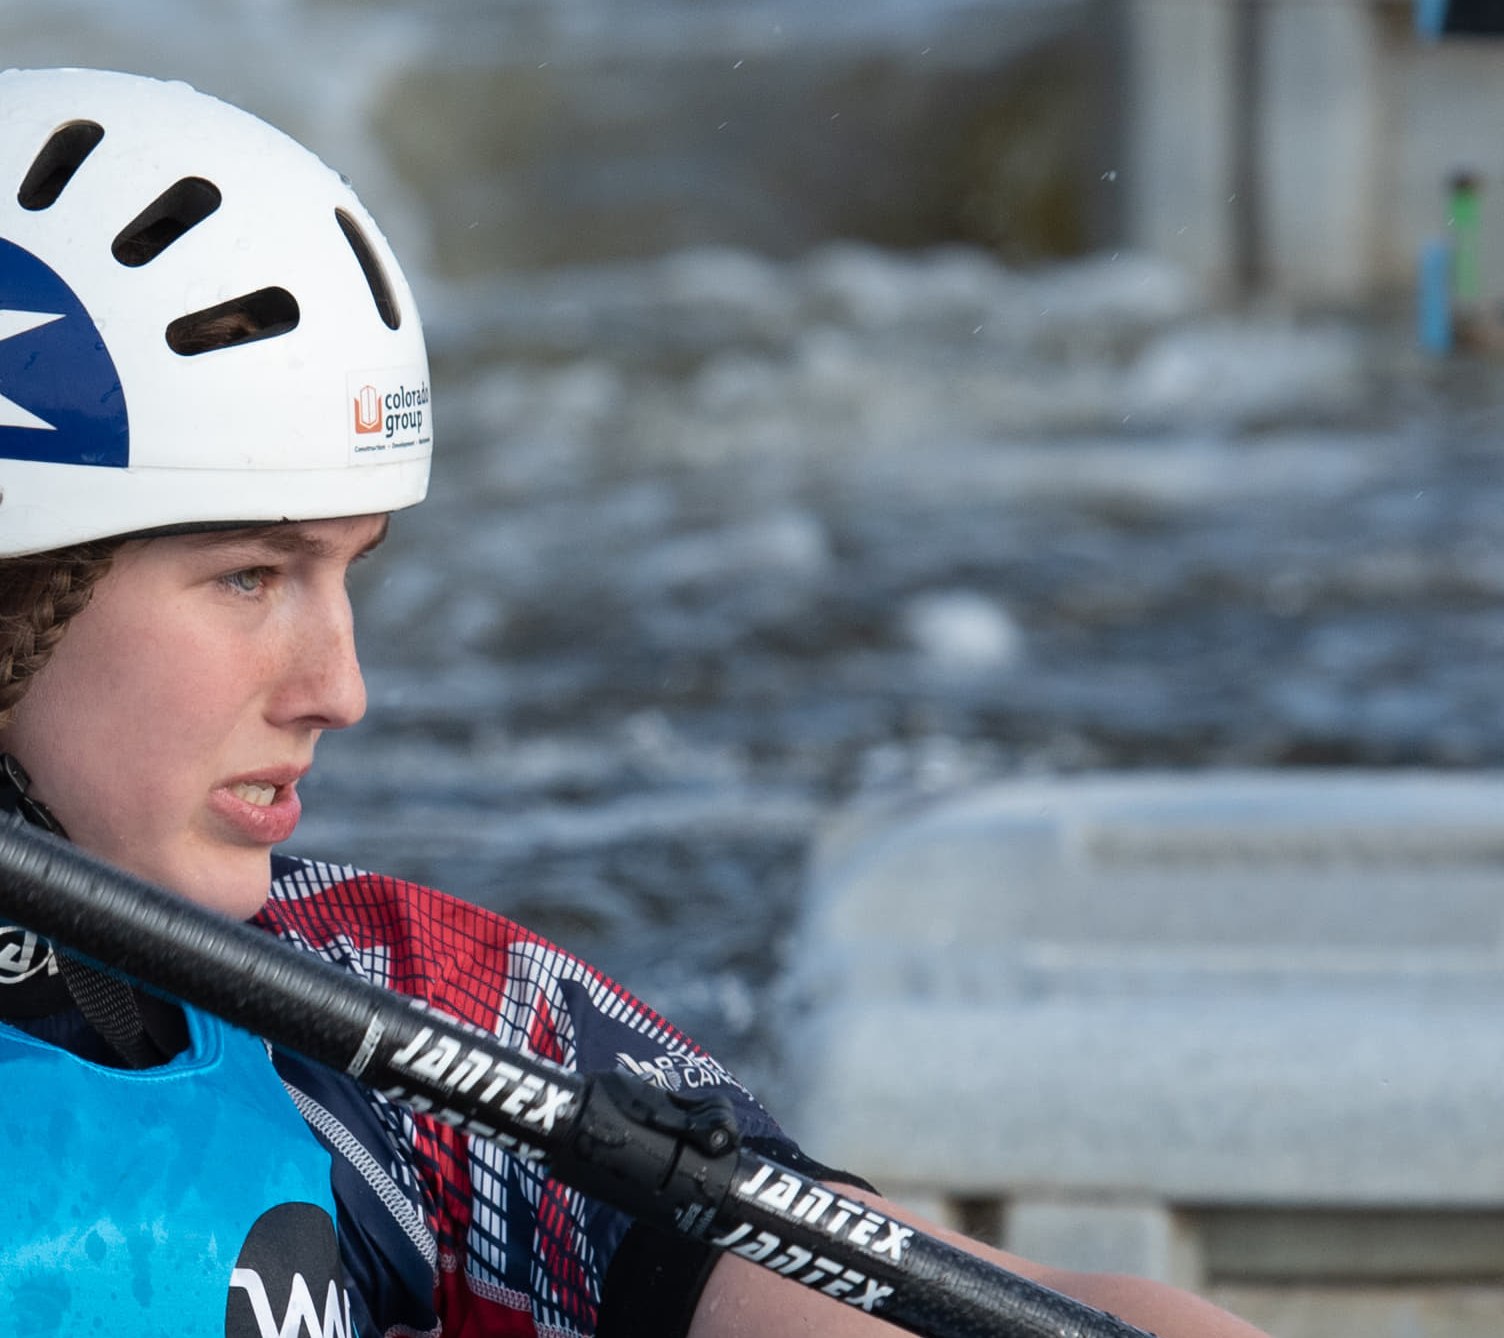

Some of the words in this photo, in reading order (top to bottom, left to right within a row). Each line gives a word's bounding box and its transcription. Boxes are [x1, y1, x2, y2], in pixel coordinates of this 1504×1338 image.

[384, 380, 429, 410] colorado
[384, 409, 423, 439] group
[390, 1025, 575, 1136] JANTEX
[739, 1163, 916, 1265] JANTEX
[712, 1221, 895, 1312] JANTEX
